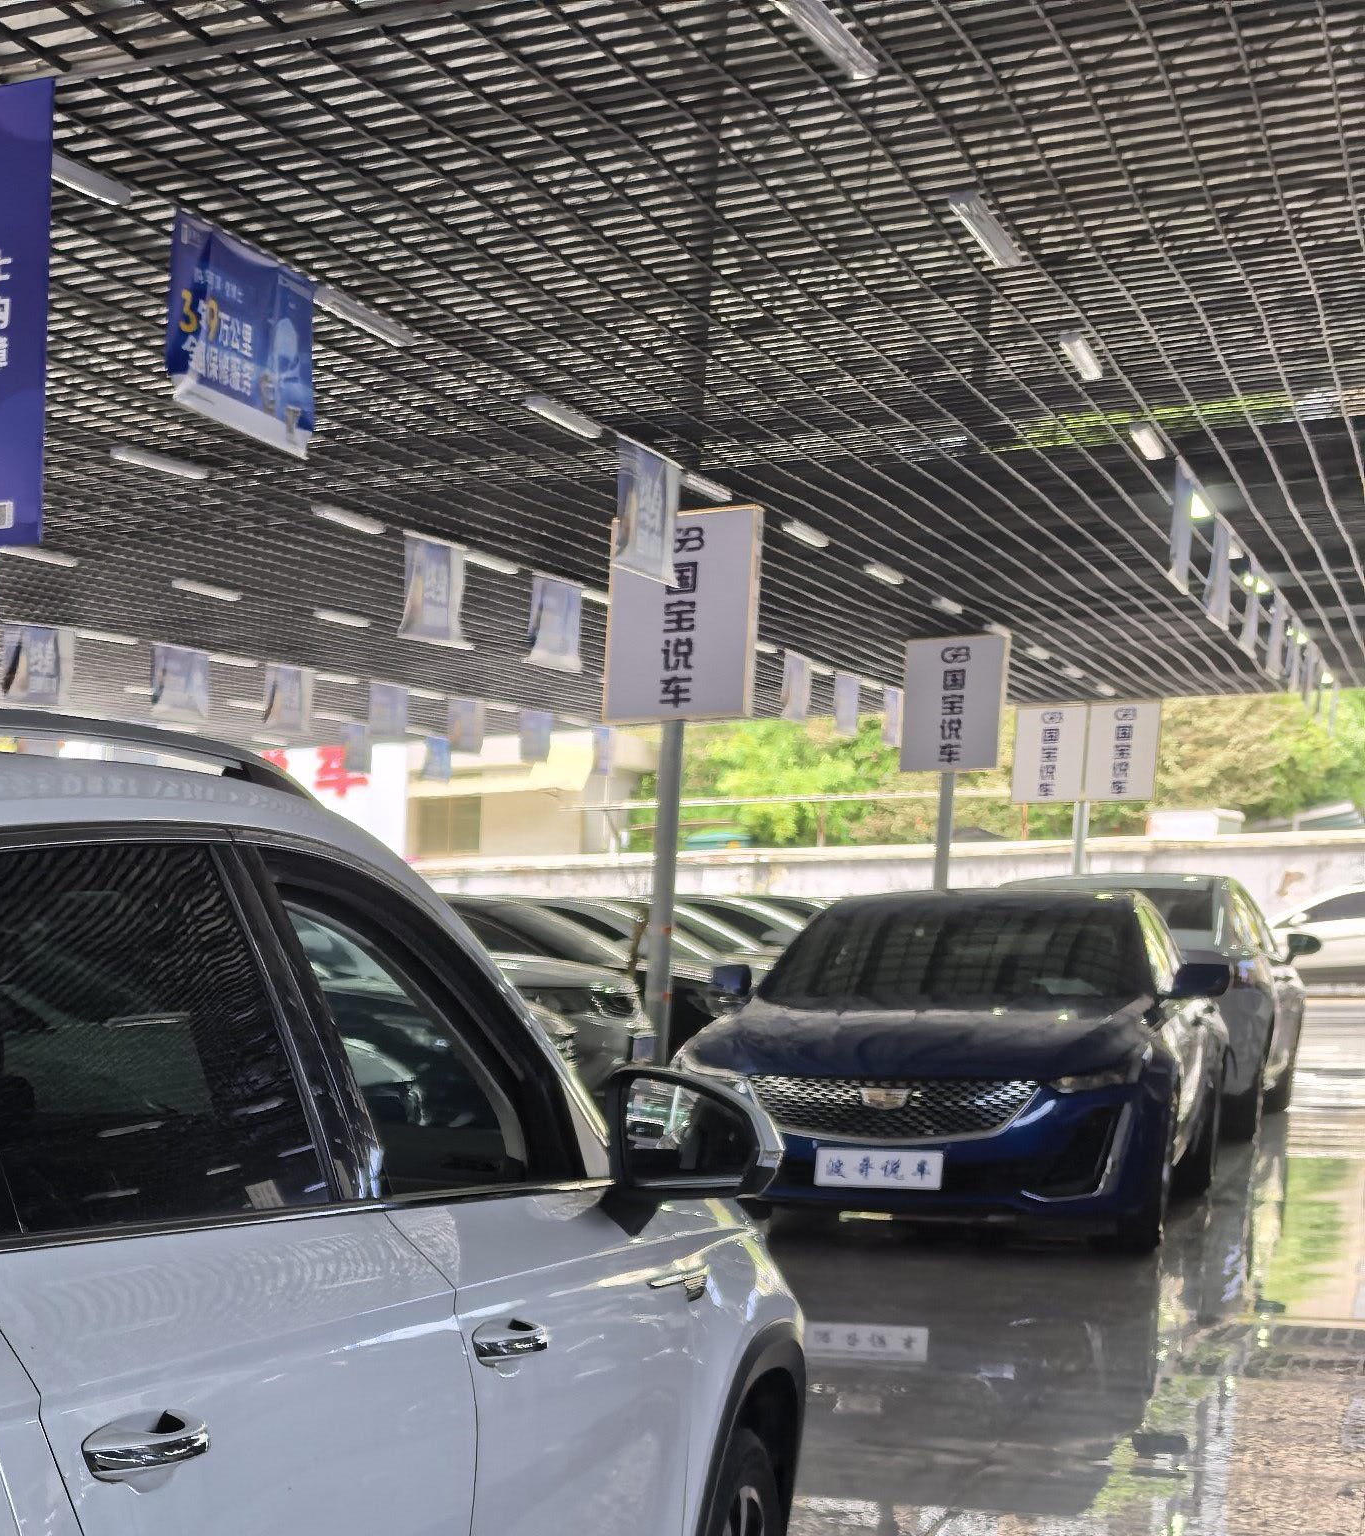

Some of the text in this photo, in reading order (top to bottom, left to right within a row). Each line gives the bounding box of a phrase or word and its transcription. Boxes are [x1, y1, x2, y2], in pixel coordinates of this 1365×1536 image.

[659, 561, 698, 708] 国宝说车
[937, 669, 966, 765] 国宝说车
